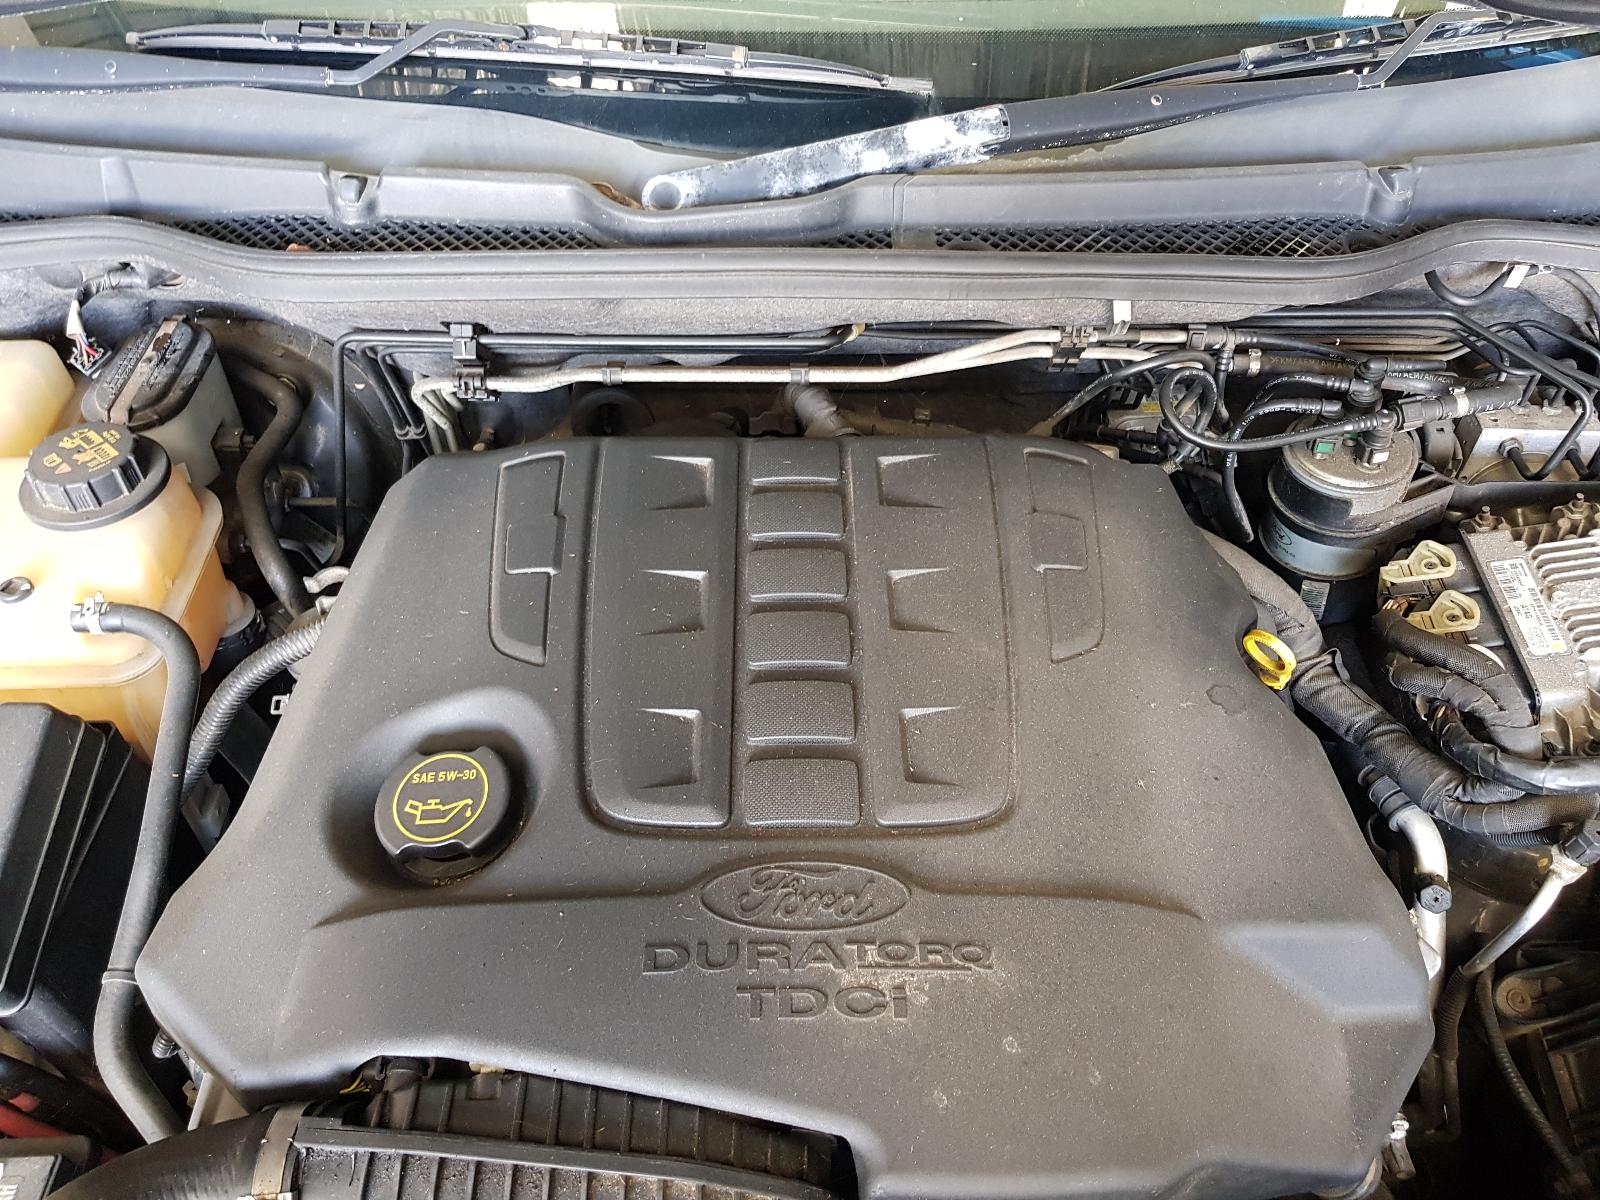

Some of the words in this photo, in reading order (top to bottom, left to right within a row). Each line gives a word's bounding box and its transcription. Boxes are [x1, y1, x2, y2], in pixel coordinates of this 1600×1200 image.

[412, 771, 436, 784] SAE
[438, 769, 477, 782] 5W-30
[735, 867, 876, 920] Ford
[642, 941, 995, 976] DURATORQ
